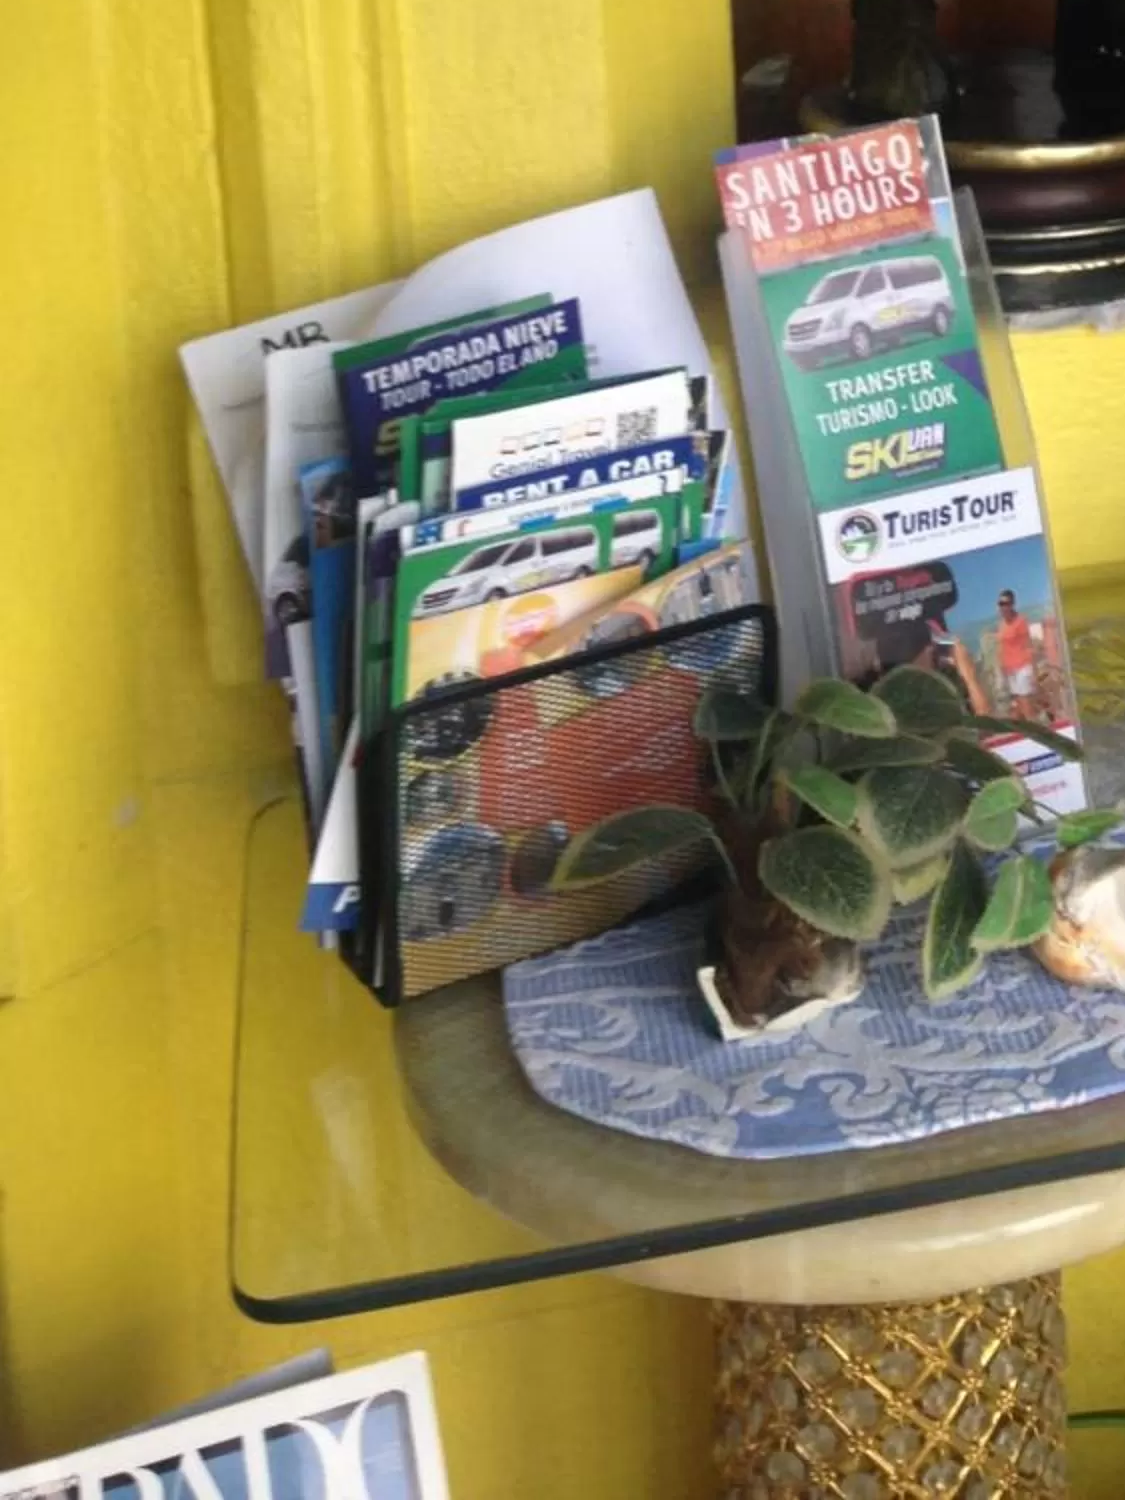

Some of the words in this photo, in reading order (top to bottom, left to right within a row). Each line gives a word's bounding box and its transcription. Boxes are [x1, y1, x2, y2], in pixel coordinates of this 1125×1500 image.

[726, 135, 913, 209] SANTIAGO
[780, 200, 803, 232] 3
[810, 171, 920, 227] HOURS
[362, 332, 502, 393] TEMPORADA
[503, 310, 568, 349] NIEVE
[825, 359, 936, 404] TRANSFER
[380, 379, 432, 412] TOUR
[444, 359, 495, 390] TODO
[495, 352, 517, 375] EL
[815, 397, 899, 437] TURISMO
[910, 382, 958, 414] LOOK
